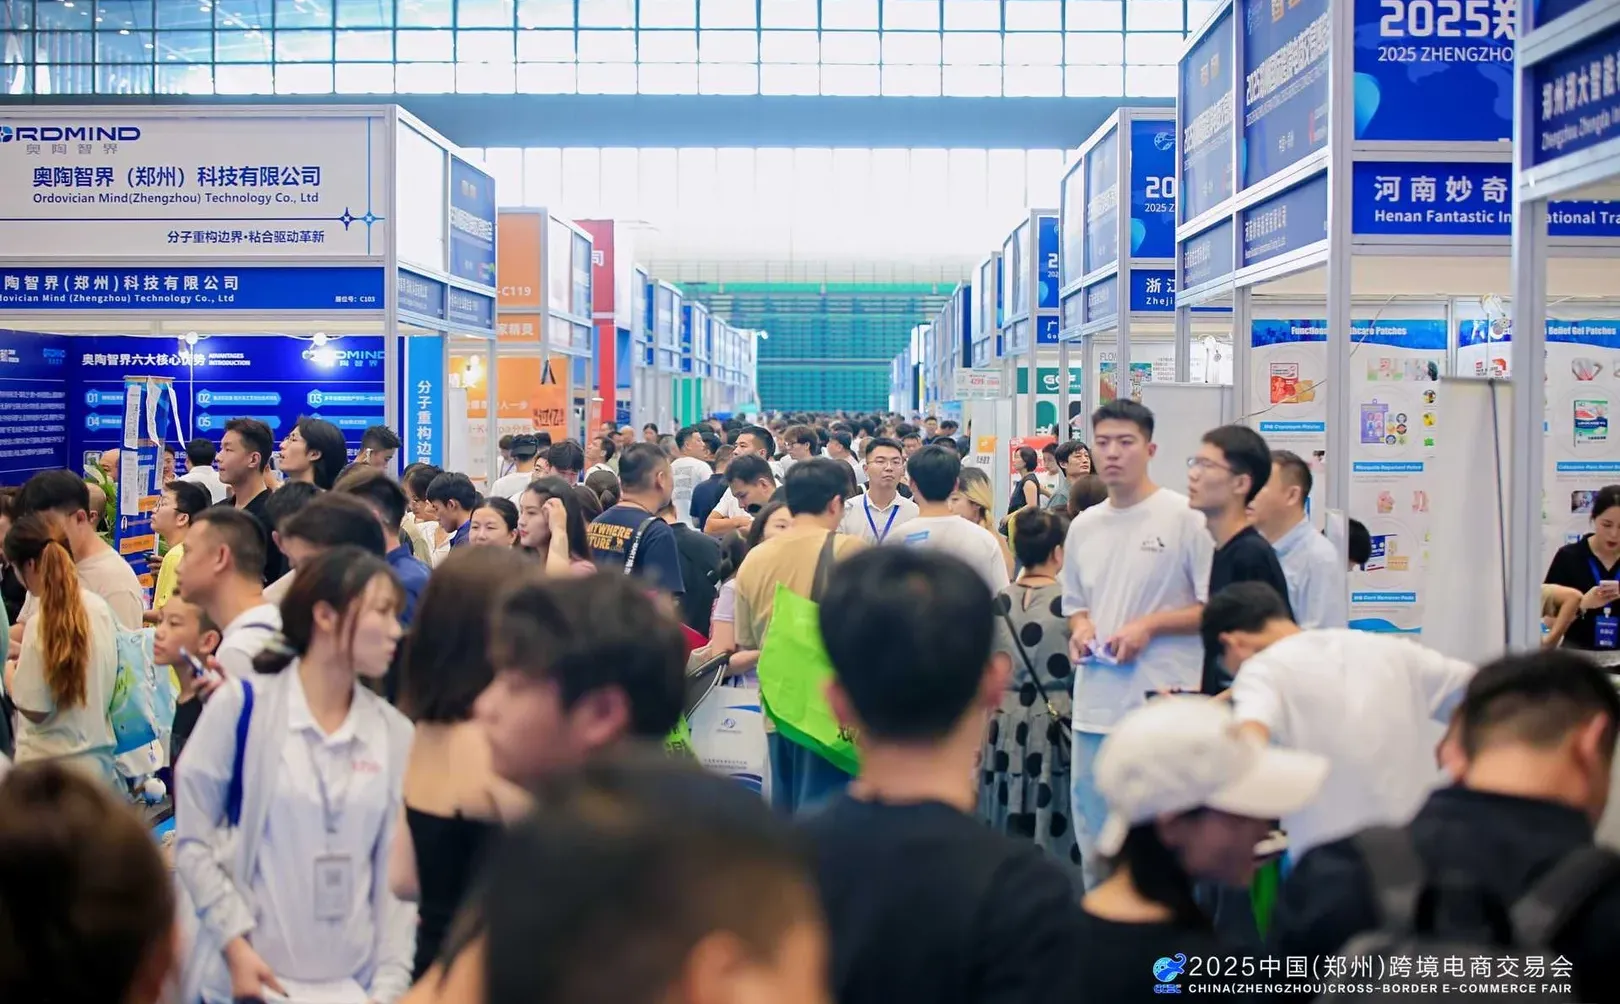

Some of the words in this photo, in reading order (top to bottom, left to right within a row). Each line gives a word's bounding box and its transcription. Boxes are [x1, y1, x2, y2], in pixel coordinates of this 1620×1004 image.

[1378, 47, 1416, 62] 2025
[1420, 47, 1514, 62] ZHENGZHO
[26, 143, 118, 155] 奥陶智界
[33, 166, 321, 188] 奥陶智界（郑州）科技有限公司
[1146, 177, 1175, 198] 20
[1374, 176, 1508, 203] 河南妙奇
[33, 193, 95, 203] Ordovician
[98, 193, 201, 205] Mind(Zhengzhou)
[205, 193, 272, 205] Technology
[275, 193, 297, 204] Co.,
[300, 193, 319, 203] Ltd
[1145, 204, 1167, 212] 2025
[1375, 210, 1422, 222] Henan
[1427, 210, 1494, 223] Fantastic
[167, 230, 325, 244] 分子重构边界·粘合驱动革新
[4, 275, 239, 291] 陶智界(郑州)科技有限公司
[43, 294, 65, 302] Mind
[69, 294, 130, 304] (Zhengzhou)
[134, 294, 192, 304] Technology
[195, 294, 215, 303] Co.,
[218, 294, 235, 302] Ltd
[86, 393, 99, 403] 01
[198, 393, 210, 403] 02
[309, 393, 322, 404] 03
[198, 416, 211, 427] 05
